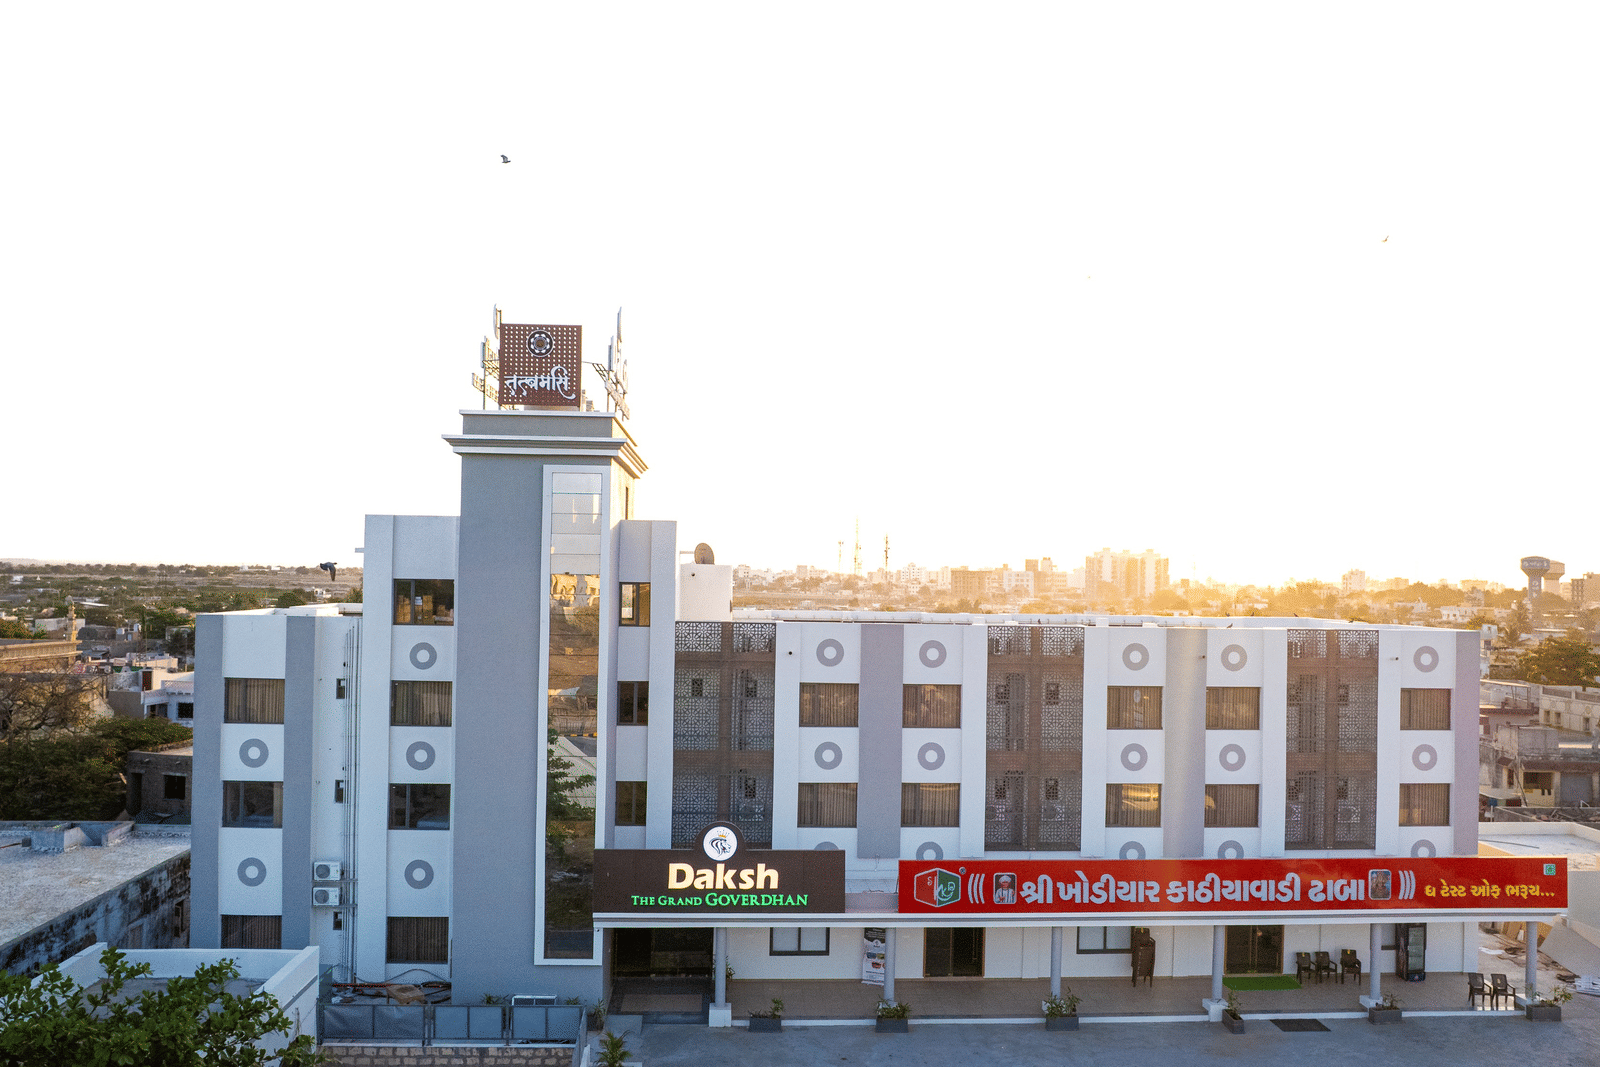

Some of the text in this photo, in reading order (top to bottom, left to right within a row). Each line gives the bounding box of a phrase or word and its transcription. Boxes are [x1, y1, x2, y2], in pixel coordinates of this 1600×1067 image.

[668, 863, 779, 890] Daksh
[1020, 870, 1366, 905] શ્રી ખોડીયાર કાઠીયાવાડી ઢાબા
[705, 893, 809, 907] GOVERDHAN
